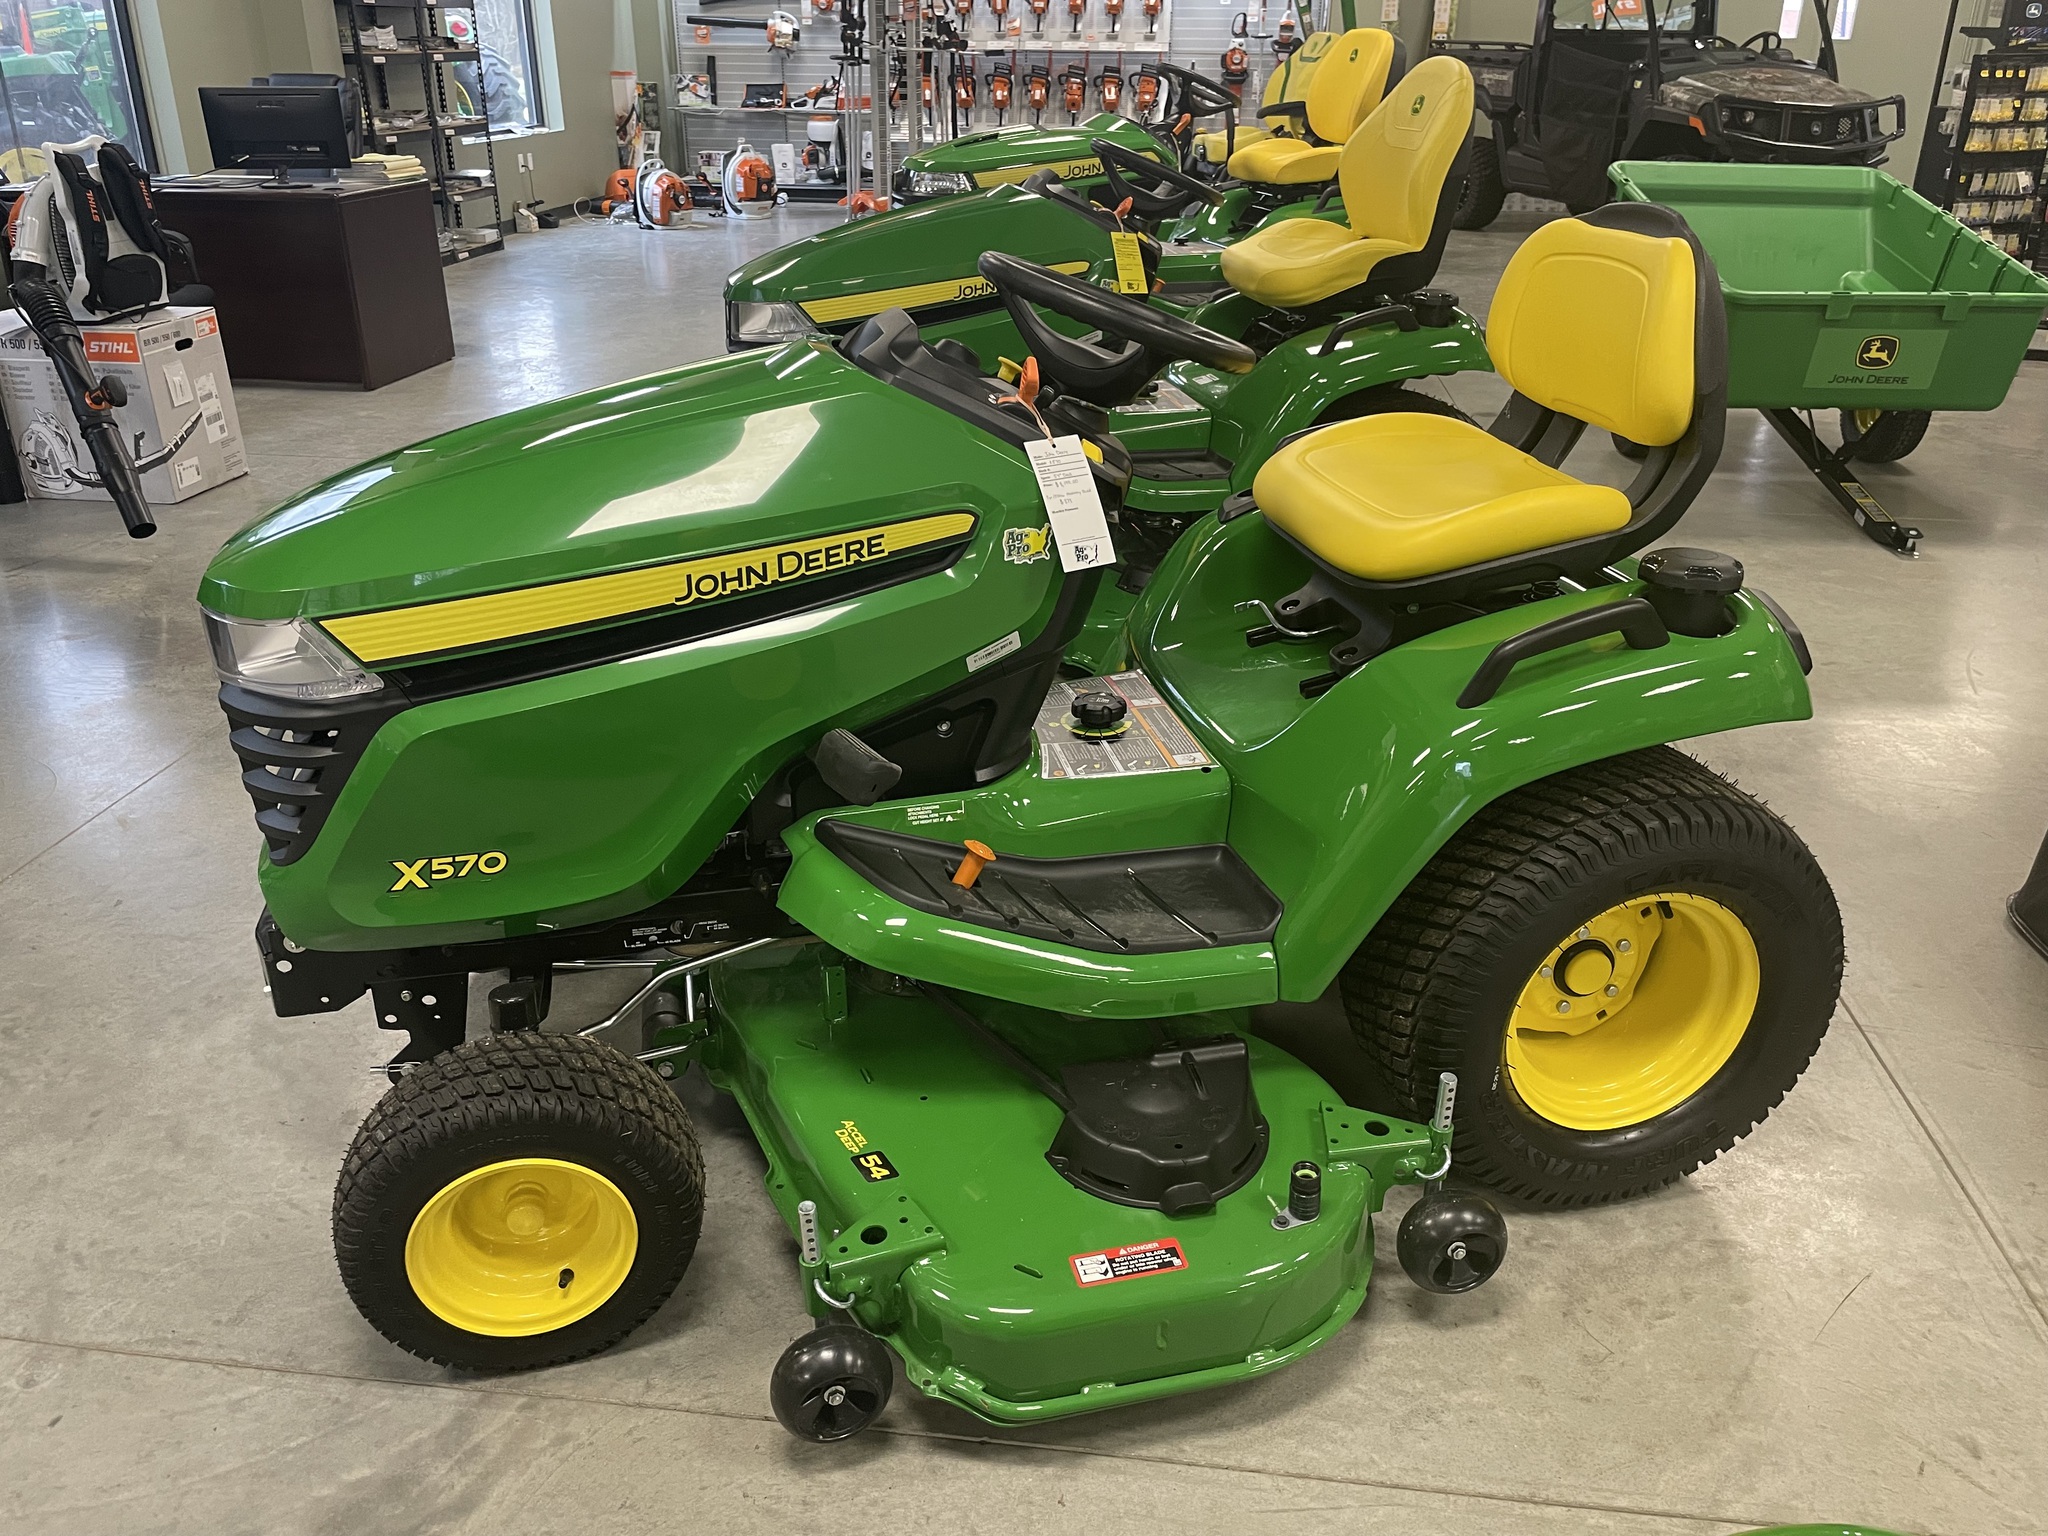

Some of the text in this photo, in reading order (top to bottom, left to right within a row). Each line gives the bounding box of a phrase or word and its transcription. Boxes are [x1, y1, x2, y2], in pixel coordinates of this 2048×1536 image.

[1063, 162, 1101, 178] JOHN
[138, 178, 153, 210] STIHL
[85, 189, 100, 222] STIHL
[953, 282, 997, 299] JOHN
[9, 338, 26, 350] 500
[89, 341, 133, 354] STIHL
[1828, 374, 1909, 385] JOHN DEERE
[1007, 531, 1030, 545] Ag-
[1007, 544, 1030, 557] Pro
[674, 534, 886, 604] JOHN DEERE
[389, 850, 508, 893] X570
[834, 1128, 860, 1154] DEEP
[840, 1120, 868, 1149] ACCEL
[859, 1154, 891, 1180] 54
[1115, 1249, 1166, 1262] ROTATING BLADE
[1127, 1243, 1159, 1253] DANGER
